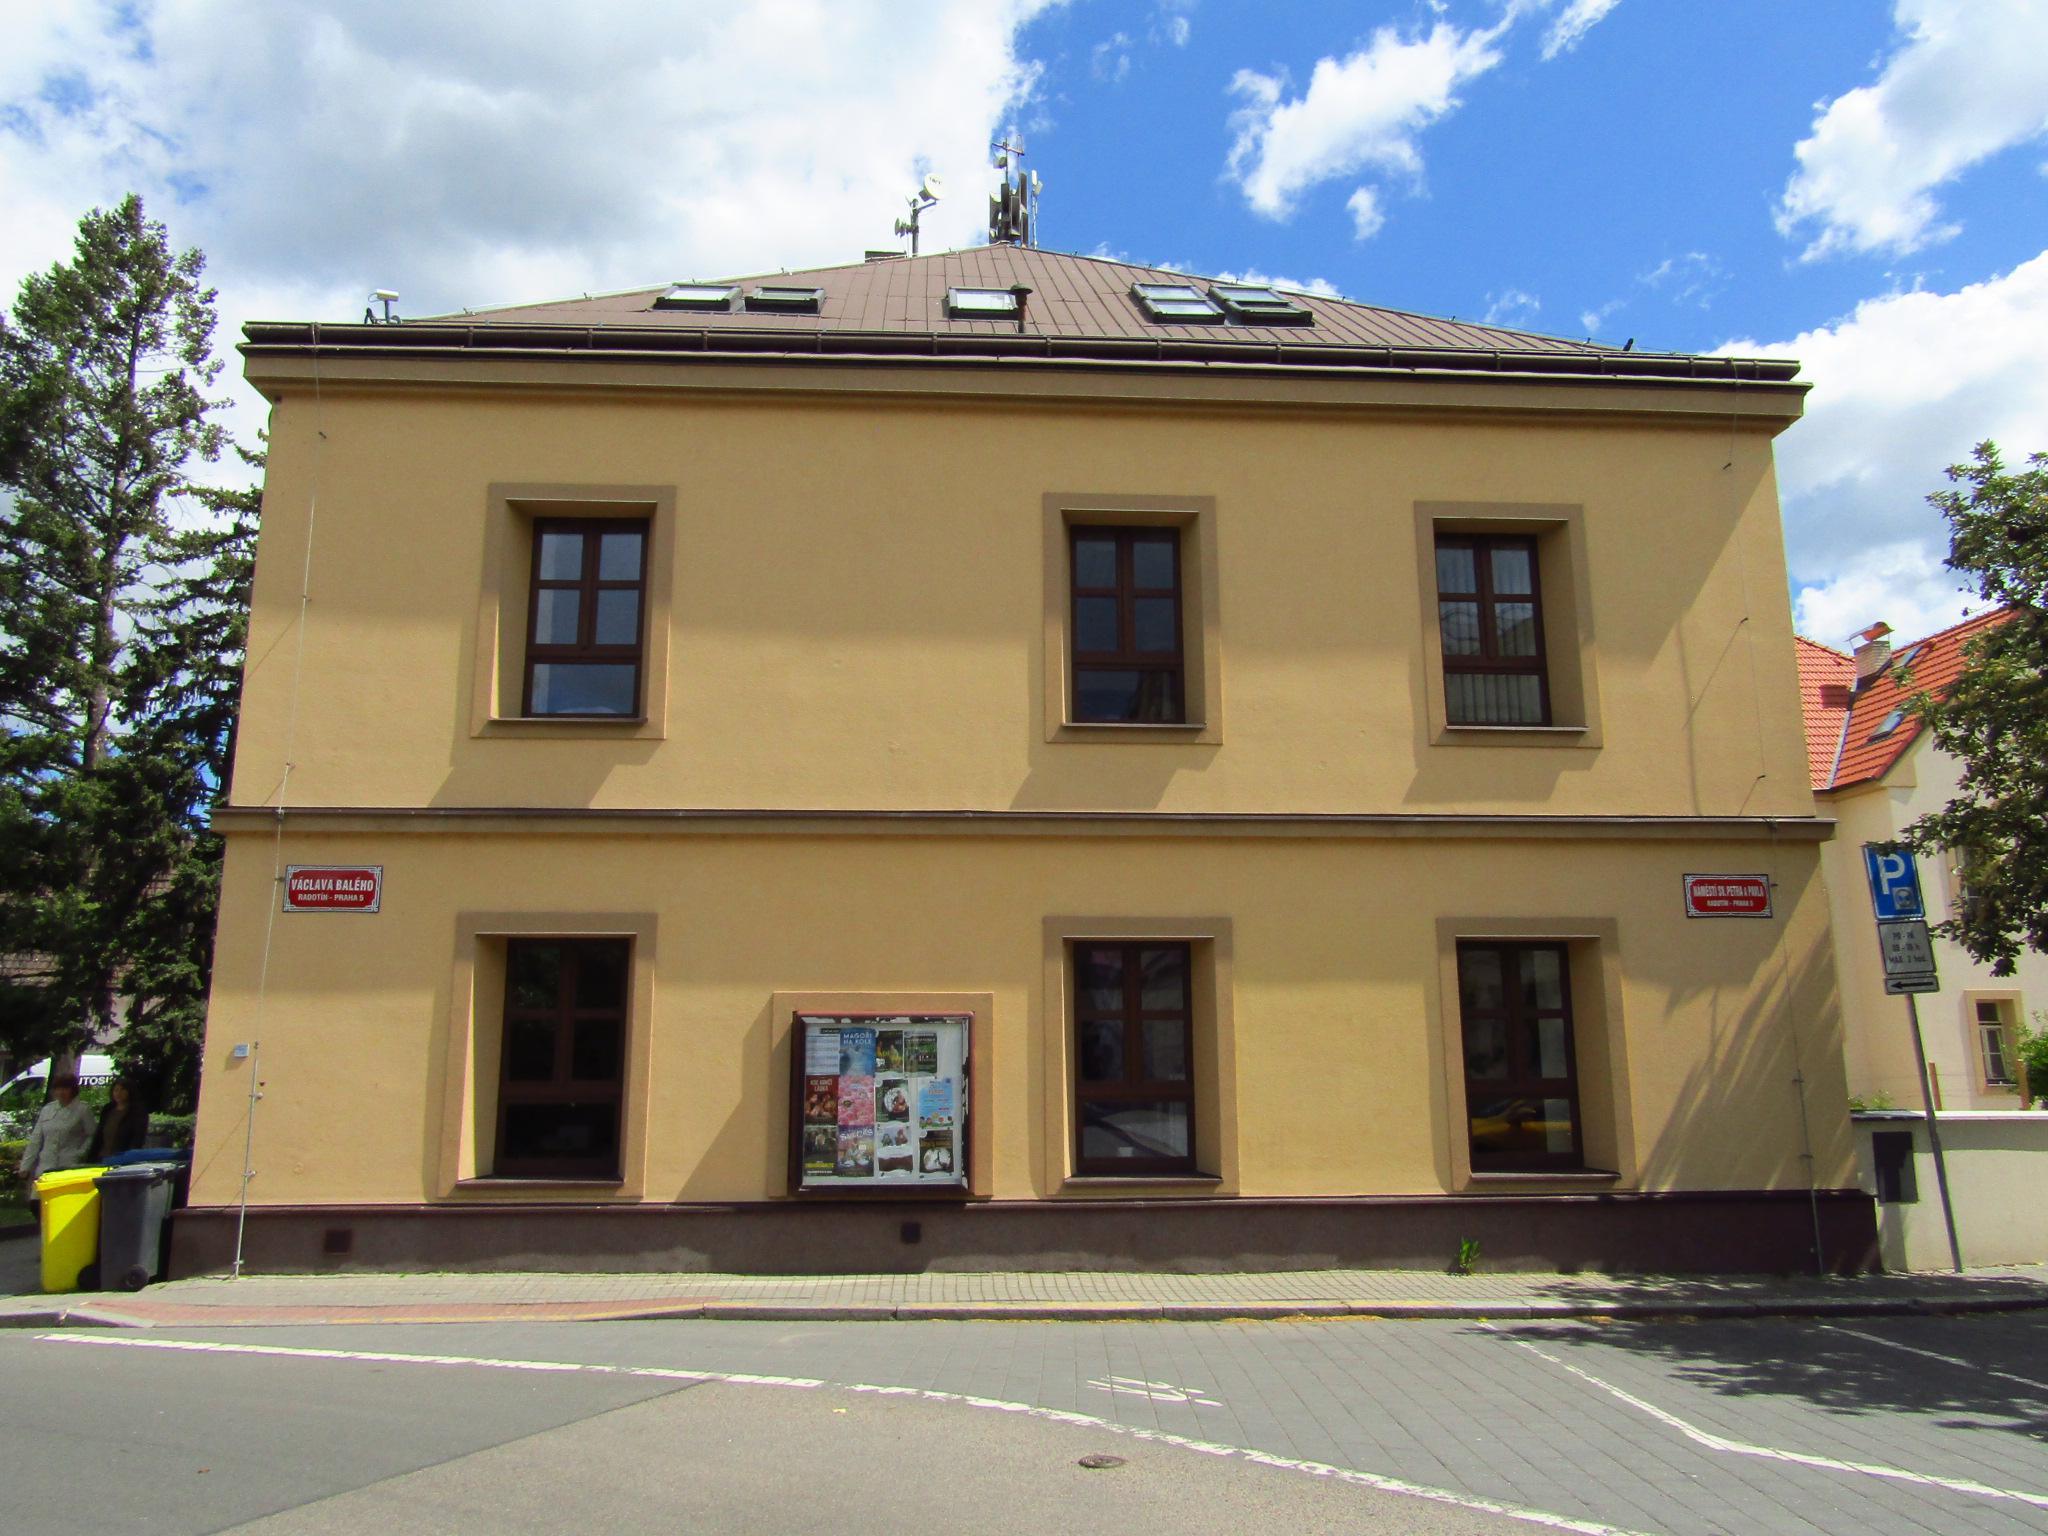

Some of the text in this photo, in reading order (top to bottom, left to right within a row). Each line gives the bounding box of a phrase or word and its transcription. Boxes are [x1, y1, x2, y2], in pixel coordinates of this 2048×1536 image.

[1876, 853, 1905, 895] P
[291, 876, 374, 891] VÁCLAVA BALÉHO
[298, 892, 328, 901] RADOTÍN
[359, 894, 364, 902] 5
[843, 1031, 872, 1039] MAGOŘI
